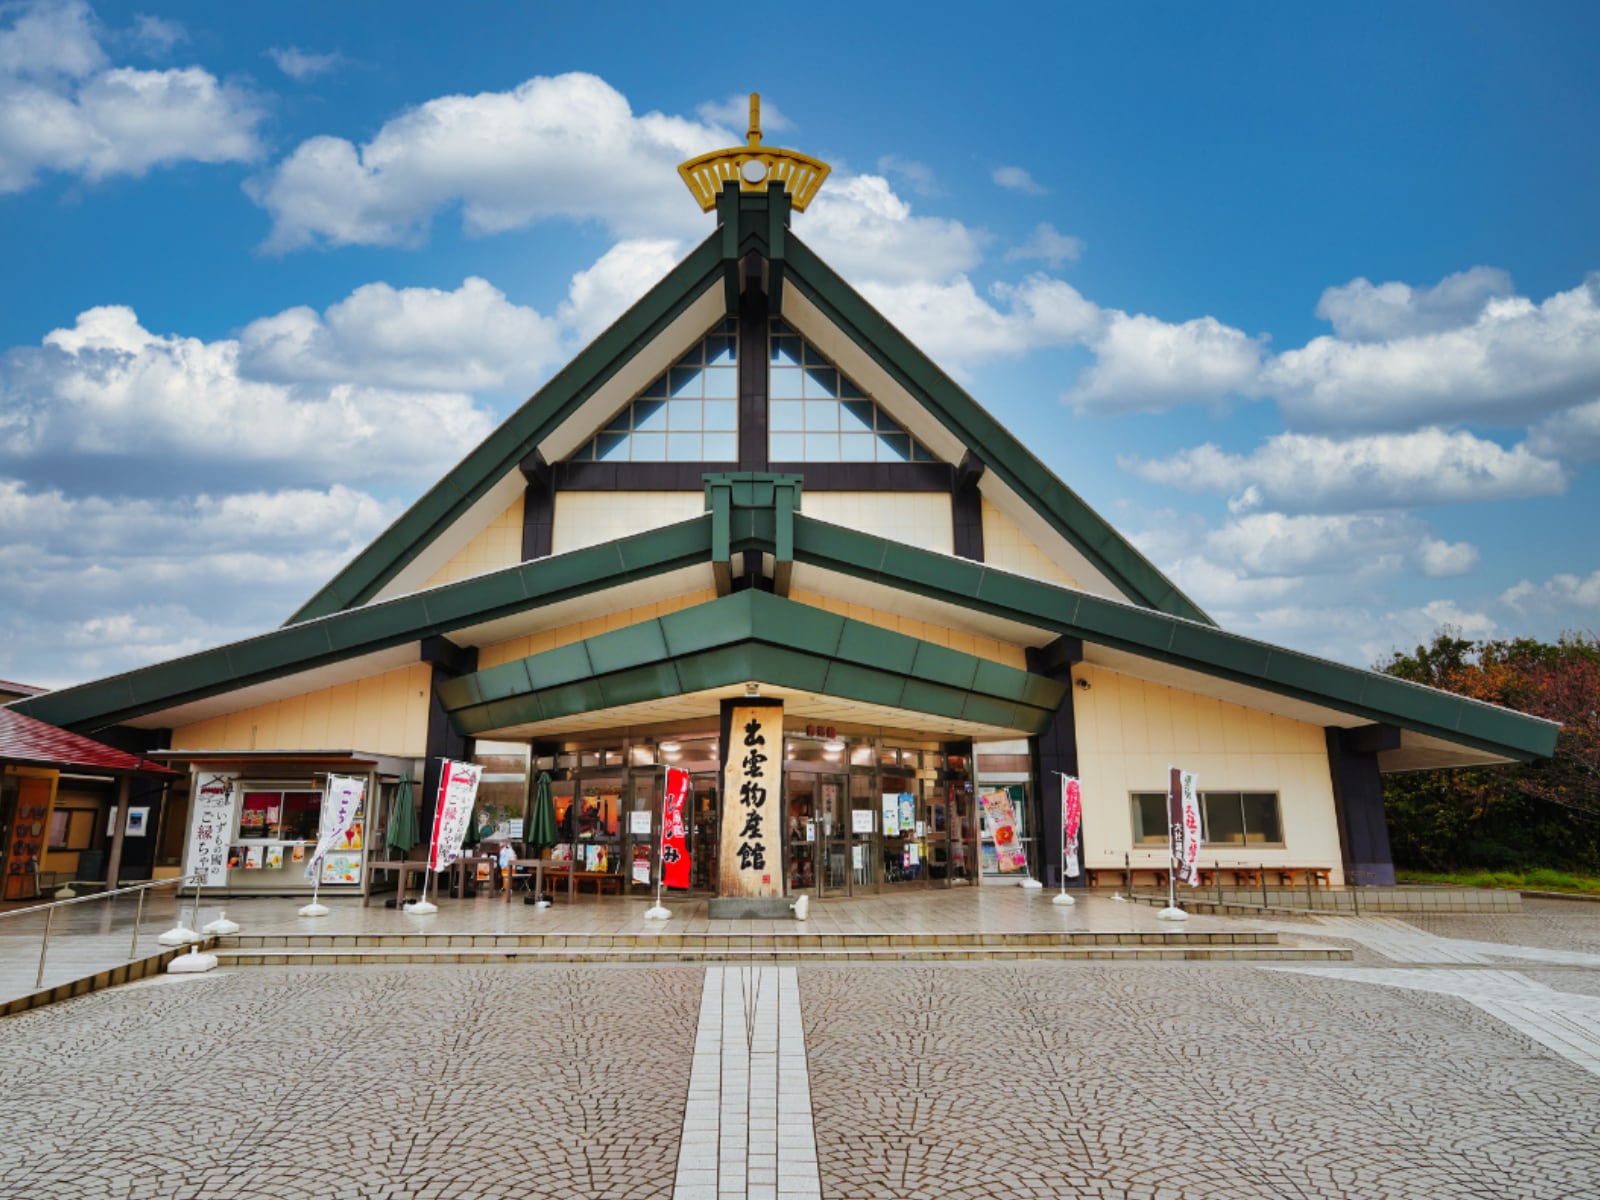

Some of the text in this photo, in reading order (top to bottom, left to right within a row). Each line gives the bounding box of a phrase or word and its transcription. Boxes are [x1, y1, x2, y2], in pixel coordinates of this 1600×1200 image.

[736, 718, 767, 871] 出雲物産館
